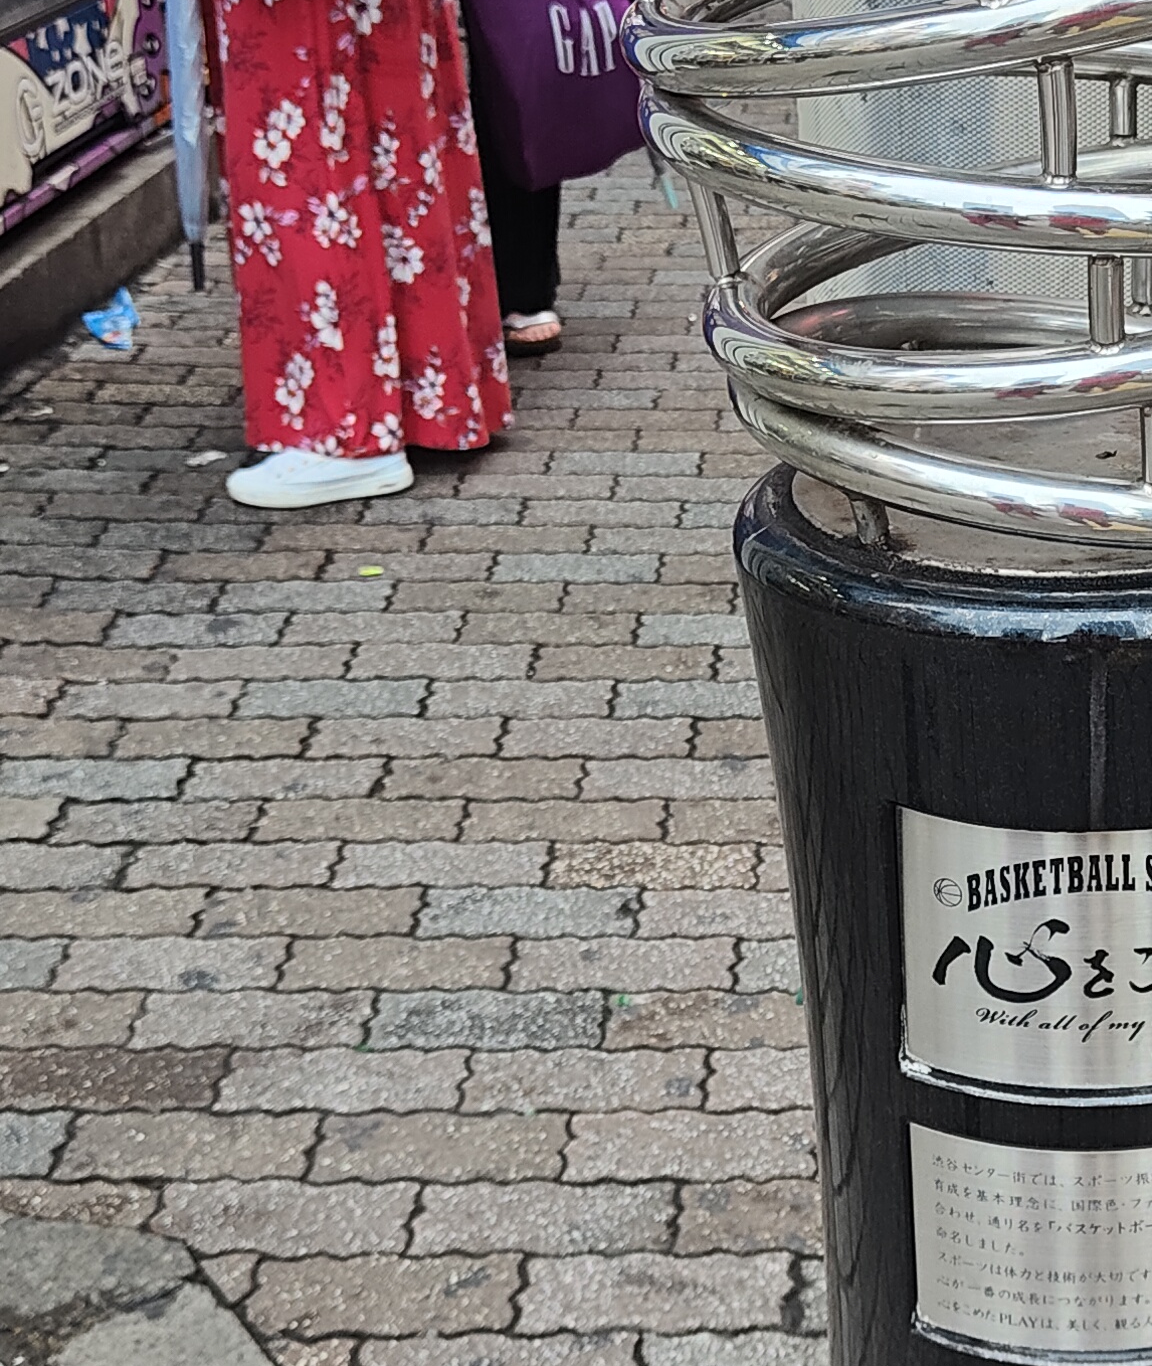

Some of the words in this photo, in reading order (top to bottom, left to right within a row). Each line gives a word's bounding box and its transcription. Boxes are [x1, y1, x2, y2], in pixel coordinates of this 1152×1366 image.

[548, 0, 617, 77] GAP
[966, 854, 1136, 913] BASKETBALL
[975, 1006, 1035, 1027] With
[1038, 1010, 1075, 1033] all
[1078, 1010, 1110, 1042] of
[1107, 1017, 1146, 1042] my
